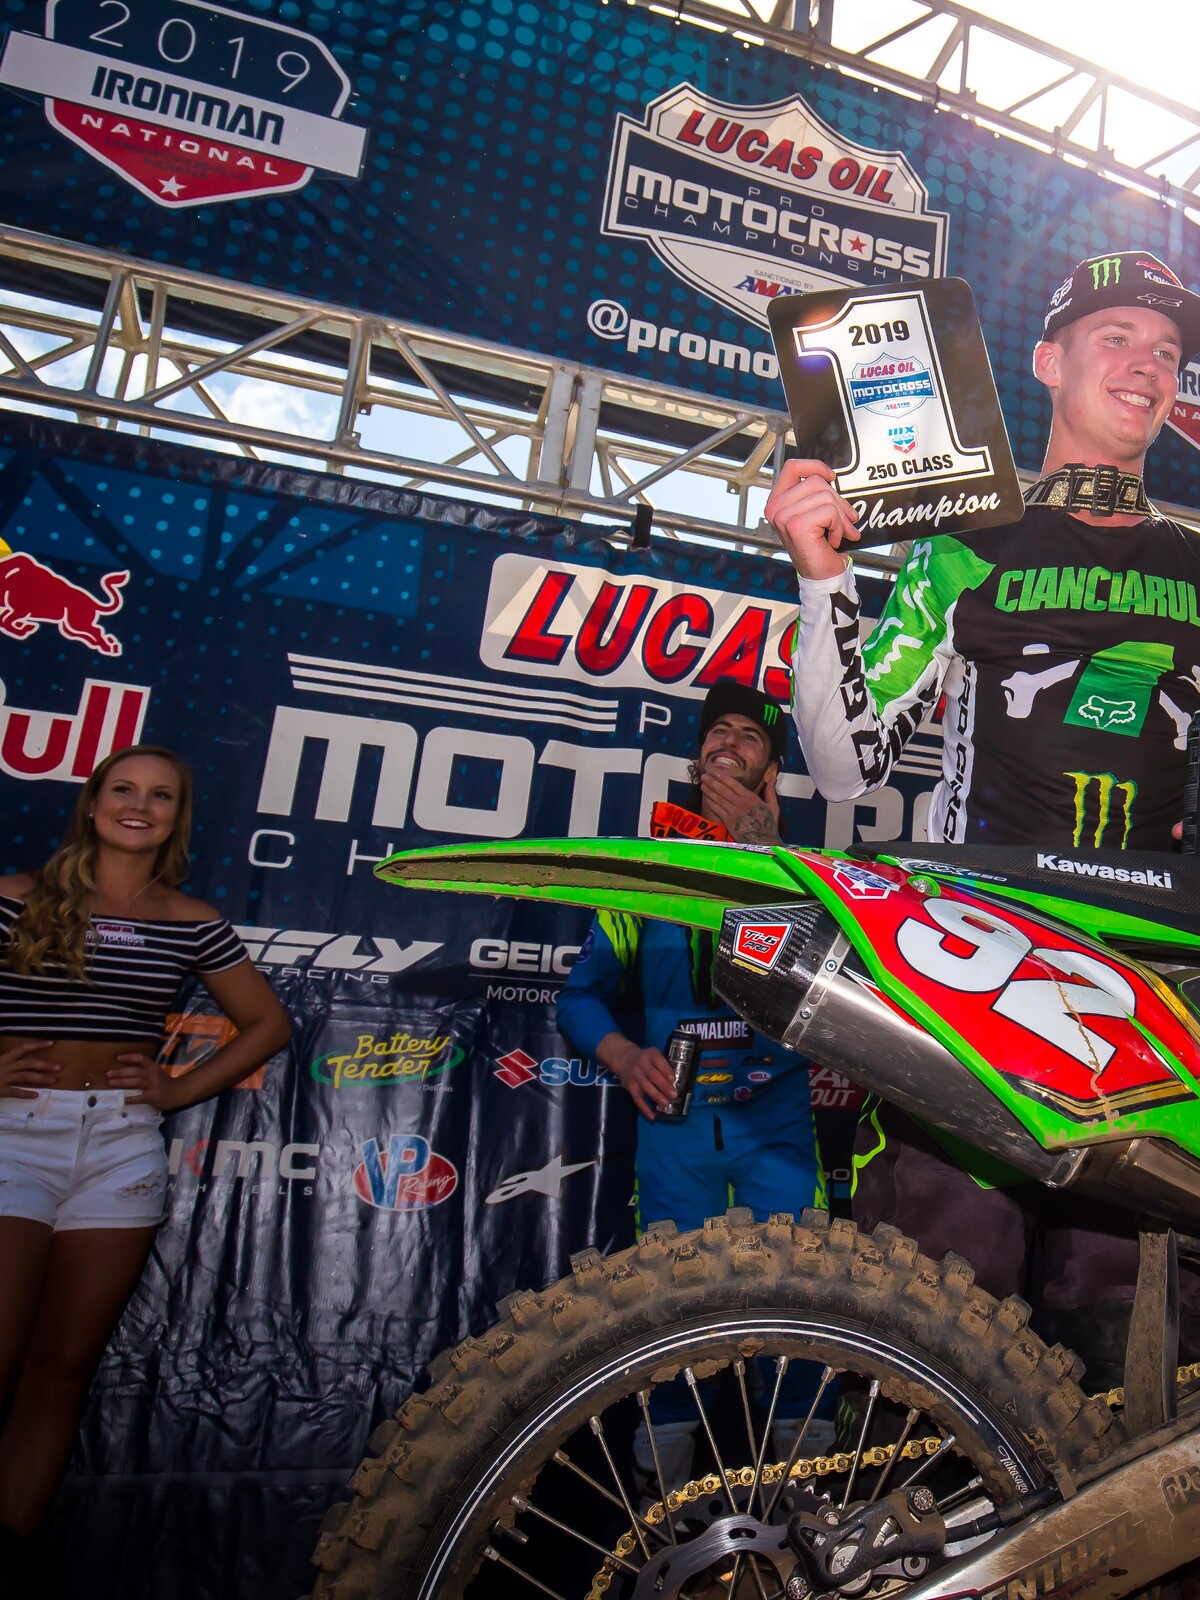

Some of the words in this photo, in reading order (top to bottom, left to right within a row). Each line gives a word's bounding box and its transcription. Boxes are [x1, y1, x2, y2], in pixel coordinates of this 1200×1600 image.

[89, 0, 311, 94] 2019
[90, 65, 286, 146] IRONMAN
[80, 113, 279, 176] NATIONAL
[676, 110, 823, 181] LUCAS
[828, 157, 896, 203] OIL
[625, 164, 931, 275] MOTOCROSS
[747, 186, 825, 217] PRO
[624, 195, 922, 284] CHAMPIONSHI
[754, 269, 802, 287] SANCTIONED
[804, 280, 814, 291] BY
[586, 299, 779, 379] @promo
[848, 319, 910, 347] 2019
[853, 379, 931, 398] MOTOCROSS
[860, 363, 896, 379] LUCAS
[897, 361, 915, 374] OIL
[866, 463, 898, 481] 250
[902, 454, 954, 475] CLASS
[851, 491, 1001, 533] Champion
[0, 684, 147, 779] ull
[1036, 852, 1173, 890] Kawasaki
[743, 941, 770, 954] PRO
[744, 929, 780, 946] Ti-6
[255, 965, 390, 984] RACING
[896, 898, 1137, 1073] 92
[354, 1032, 452, 1060] Battery
[327, 1053, 432, 1090] Tender
[363, 1133, 431, 1210] VP
[997, 1444, 1030, 1495] Takasago
